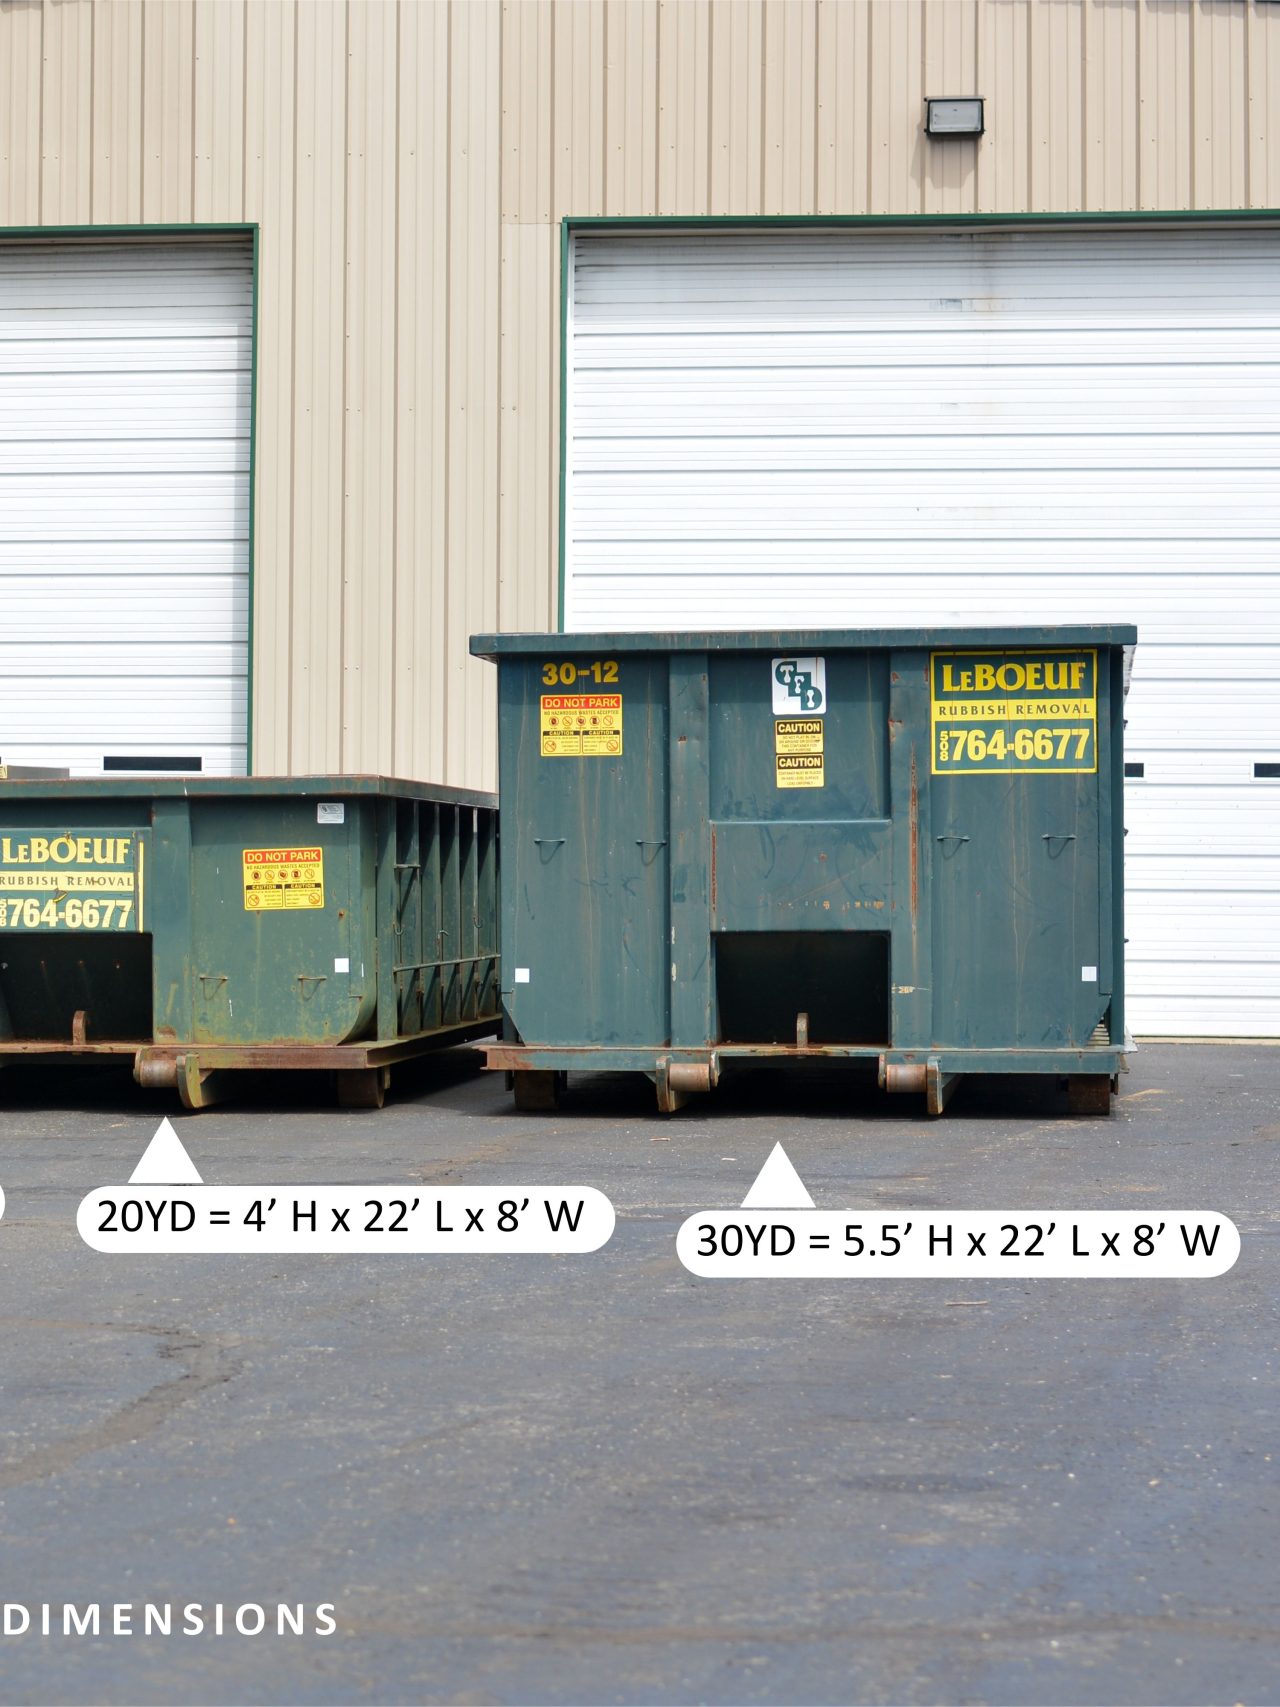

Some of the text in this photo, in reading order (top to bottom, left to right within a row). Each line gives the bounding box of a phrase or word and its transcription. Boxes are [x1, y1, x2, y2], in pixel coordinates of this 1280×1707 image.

[542, 660, 619, 686] 30-12
[544, 698, 618, 708] DO NOT PARK
[939, 703, 1090, 716] RUBBISH REMOVAL
[778, 723, 820, 733] CAUTION
[939, 728, 1090, 761] 508 764-6677
[779, 757, 821, 768] CAUTION
[247, 851, 319, 862] DO NOT PARK
[67, 874, 134, 887] REMOVAL
[7, 898, 132, 928] 764-6677
